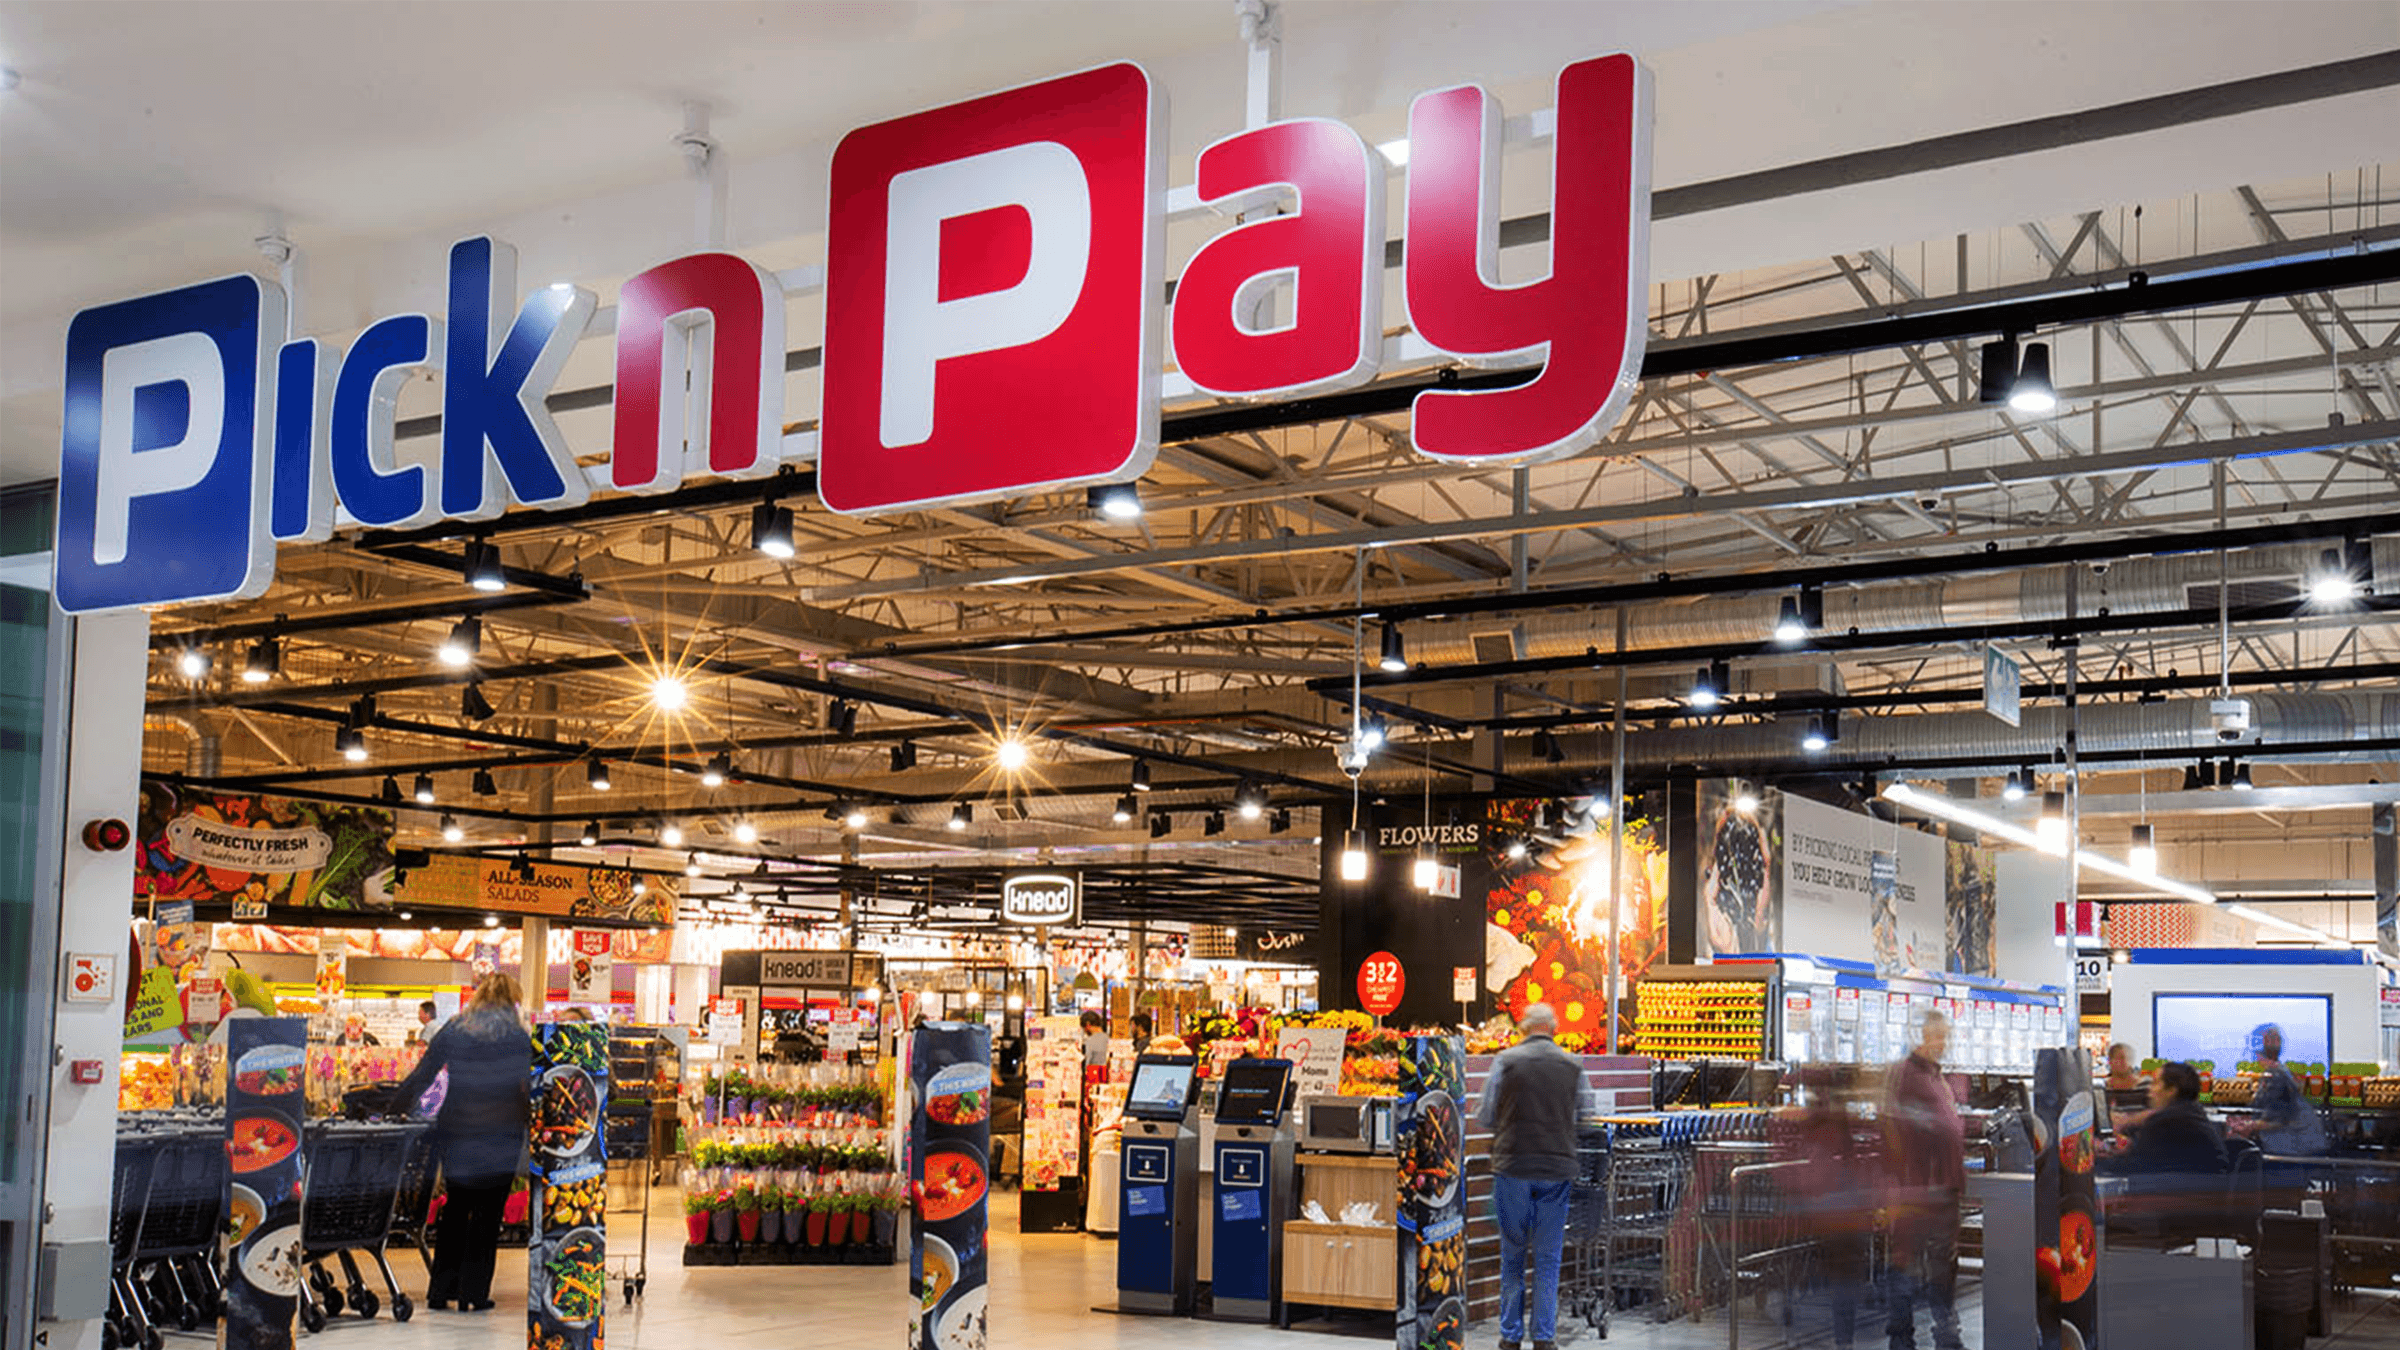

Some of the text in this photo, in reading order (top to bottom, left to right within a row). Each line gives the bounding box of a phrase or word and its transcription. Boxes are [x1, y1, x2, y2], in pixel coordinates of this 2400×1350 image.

[70, 53, 1645, 592] Pick n Pay
[193, 827, 309, 852] PERFECTLY FRESH
[1379, 824, 1479, 846] FLOWERS
[1805, 837, 1836, 860] PICKING
[1838, 844, 1862, 866] LOCAL
[1792, 861, 1810, 883] YOU
[1812, 866, 1831, 886] HELP
[1834, 869, 1858, 891] GROW
[487, 885, 540, 902] SALADS
[1010, 886, 1069, 912] knead
[764, 957, 816, 979] knead
[1385, 961, 1398, 983] 2
[2075, 961, 2101, 976] 10
